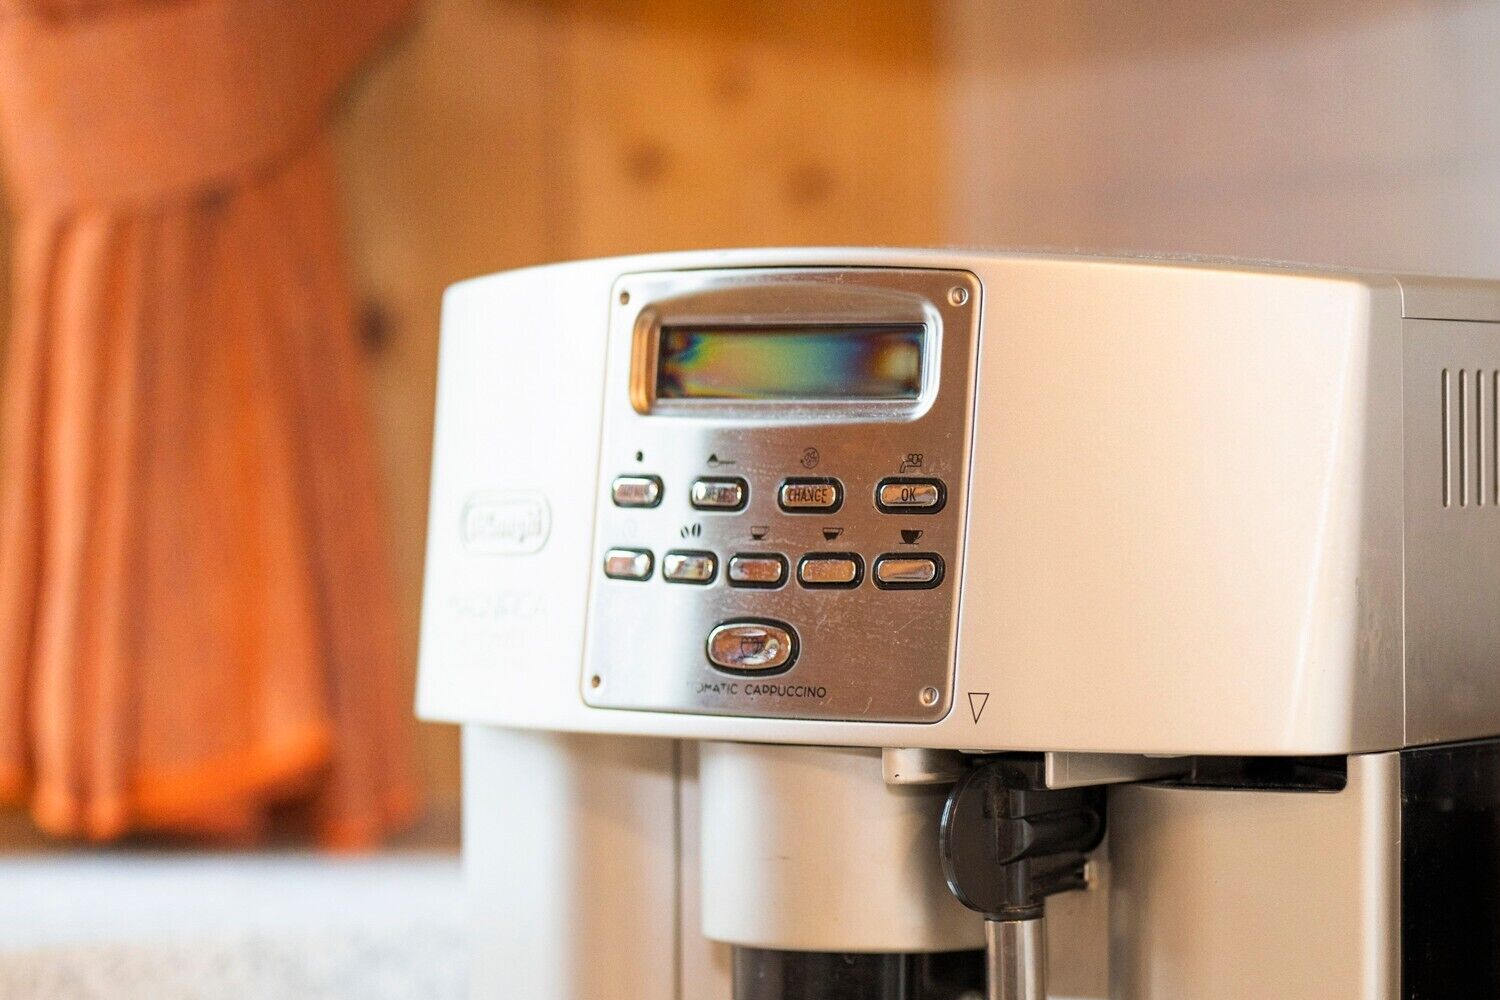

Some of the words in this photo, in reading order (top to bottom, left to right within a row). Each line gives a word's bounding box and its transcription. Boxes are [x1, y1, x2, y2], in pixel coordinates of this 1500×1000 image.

[788, 487, 828, 504] CHANGE
[901, 487, 917, 502] OK
[744, 684, 827, 698] CAPPUCCINO
